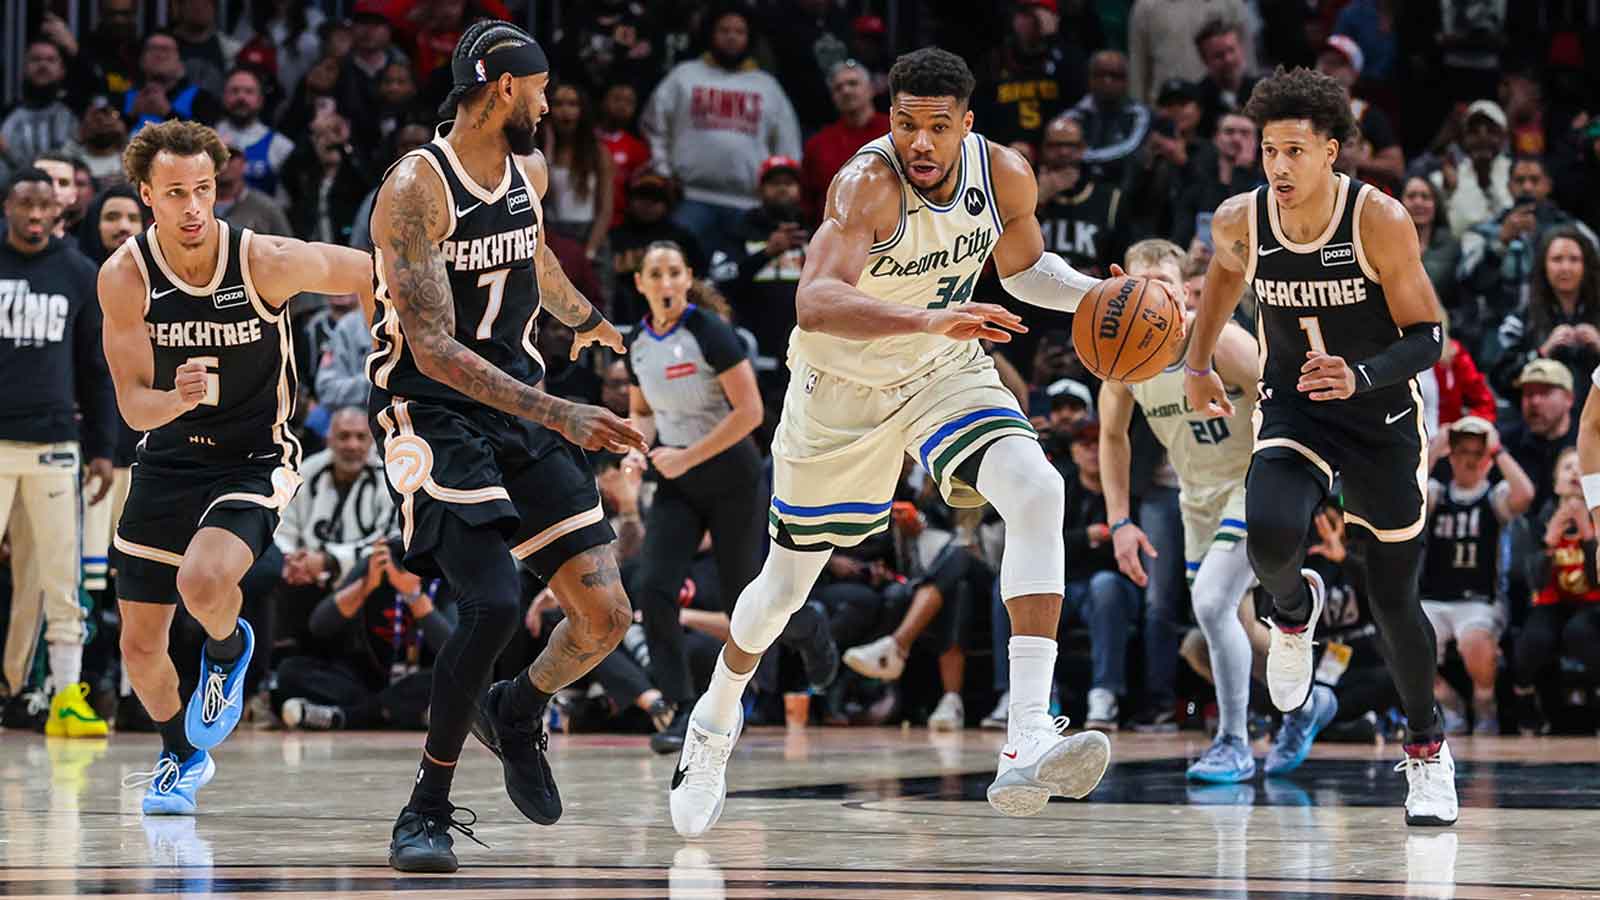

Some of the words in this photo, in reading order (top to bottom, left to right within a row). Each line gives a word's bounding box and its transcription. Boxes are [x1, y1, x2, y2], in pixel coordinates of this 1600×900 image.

[870, 255, 949, 278] Cream
[952, 226, 994, 264] City
[1323, 247, 1352, 262] paze
[215, 290, 245, 304] paze
[476, 267, 513, 340] 7
[926, 270, 978, 310] 34
[1254, 277, 1368, 307] PEACHTREE
[1100, 278, 1137, 340] Wilson
[1298, 315, 1328, 354] 1
[1188, 416, 1231, 445] 20
[1453, 542, 1478, 568] 11
